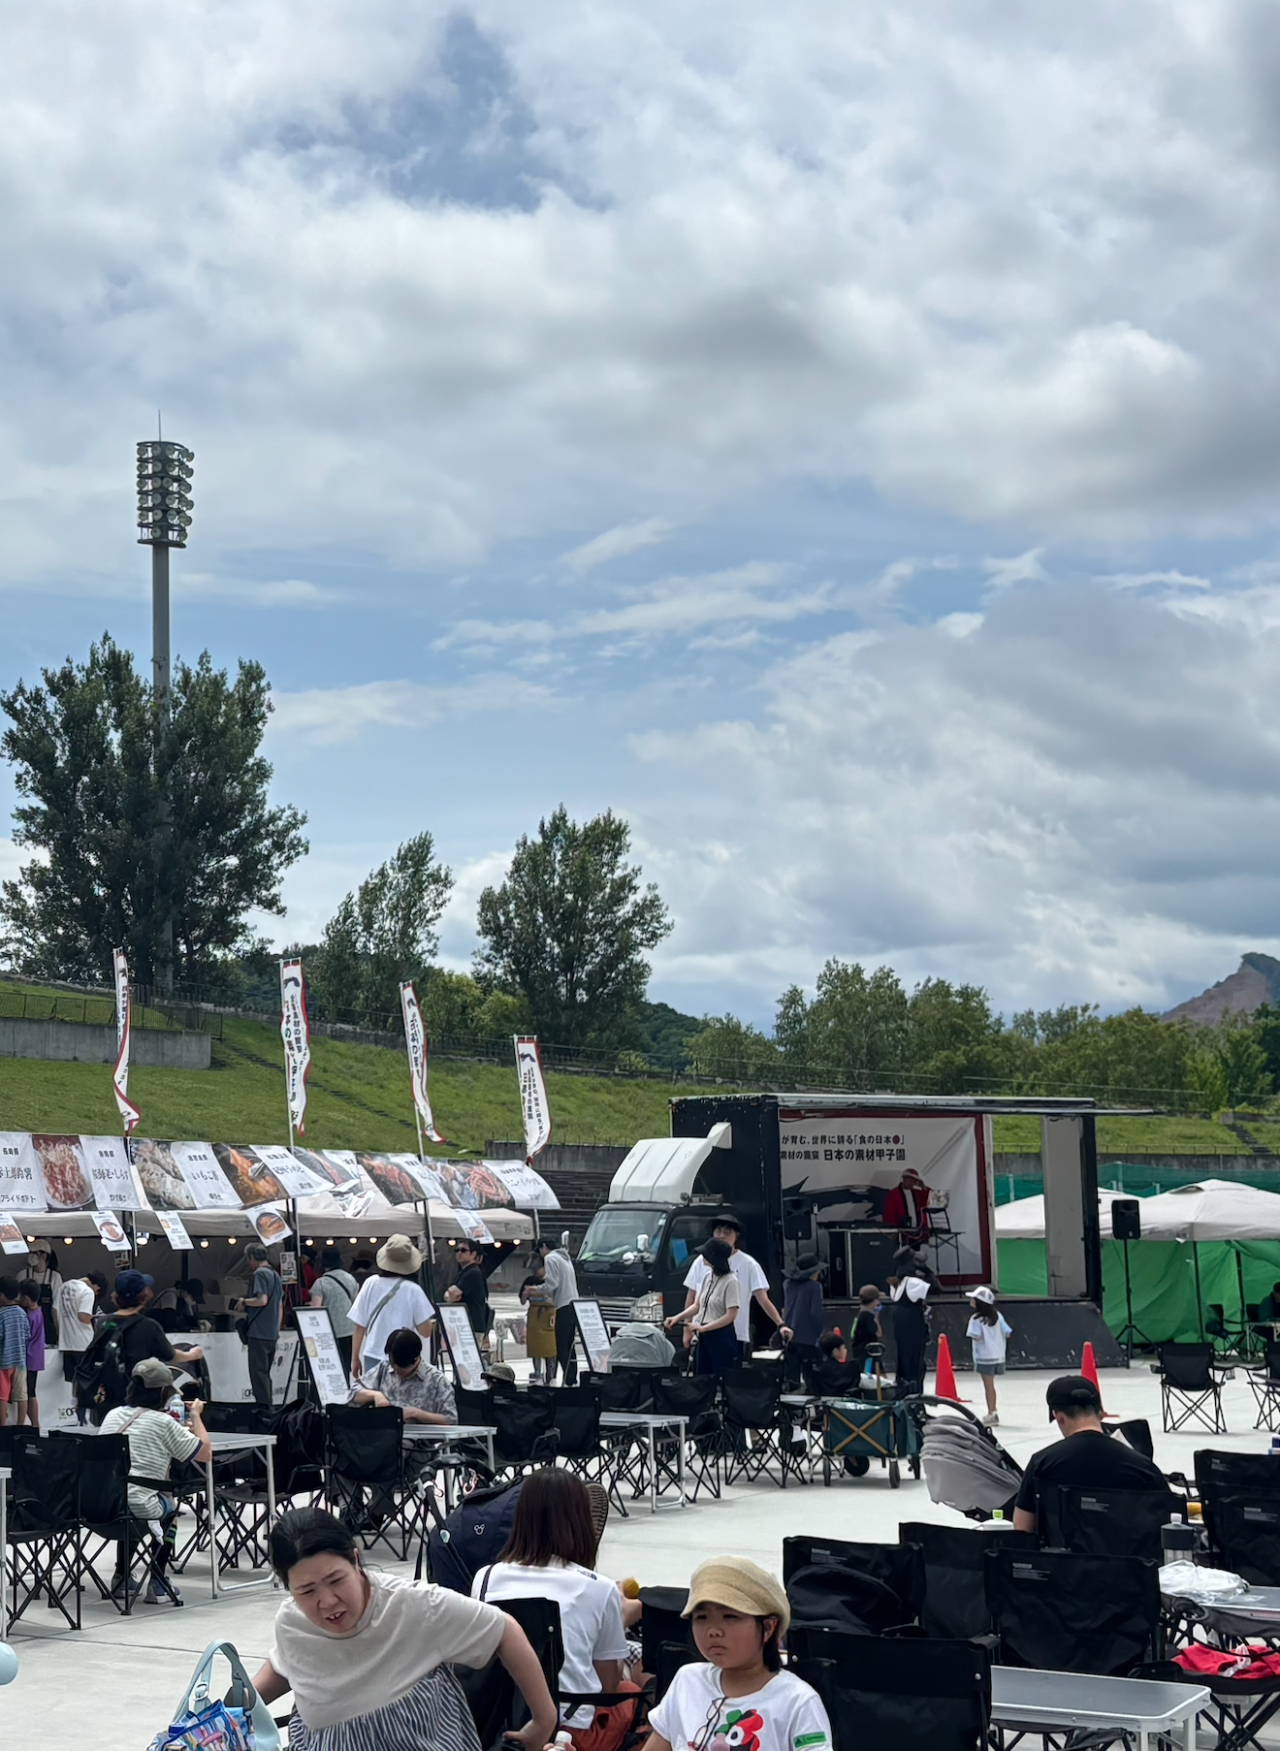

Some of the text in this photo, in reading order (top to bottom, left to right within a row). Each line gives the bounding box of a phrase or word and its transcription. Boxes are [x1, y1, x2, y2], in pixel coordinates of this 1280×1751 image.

[824, 1149, 906, 1161] 日本の素材甲子園
